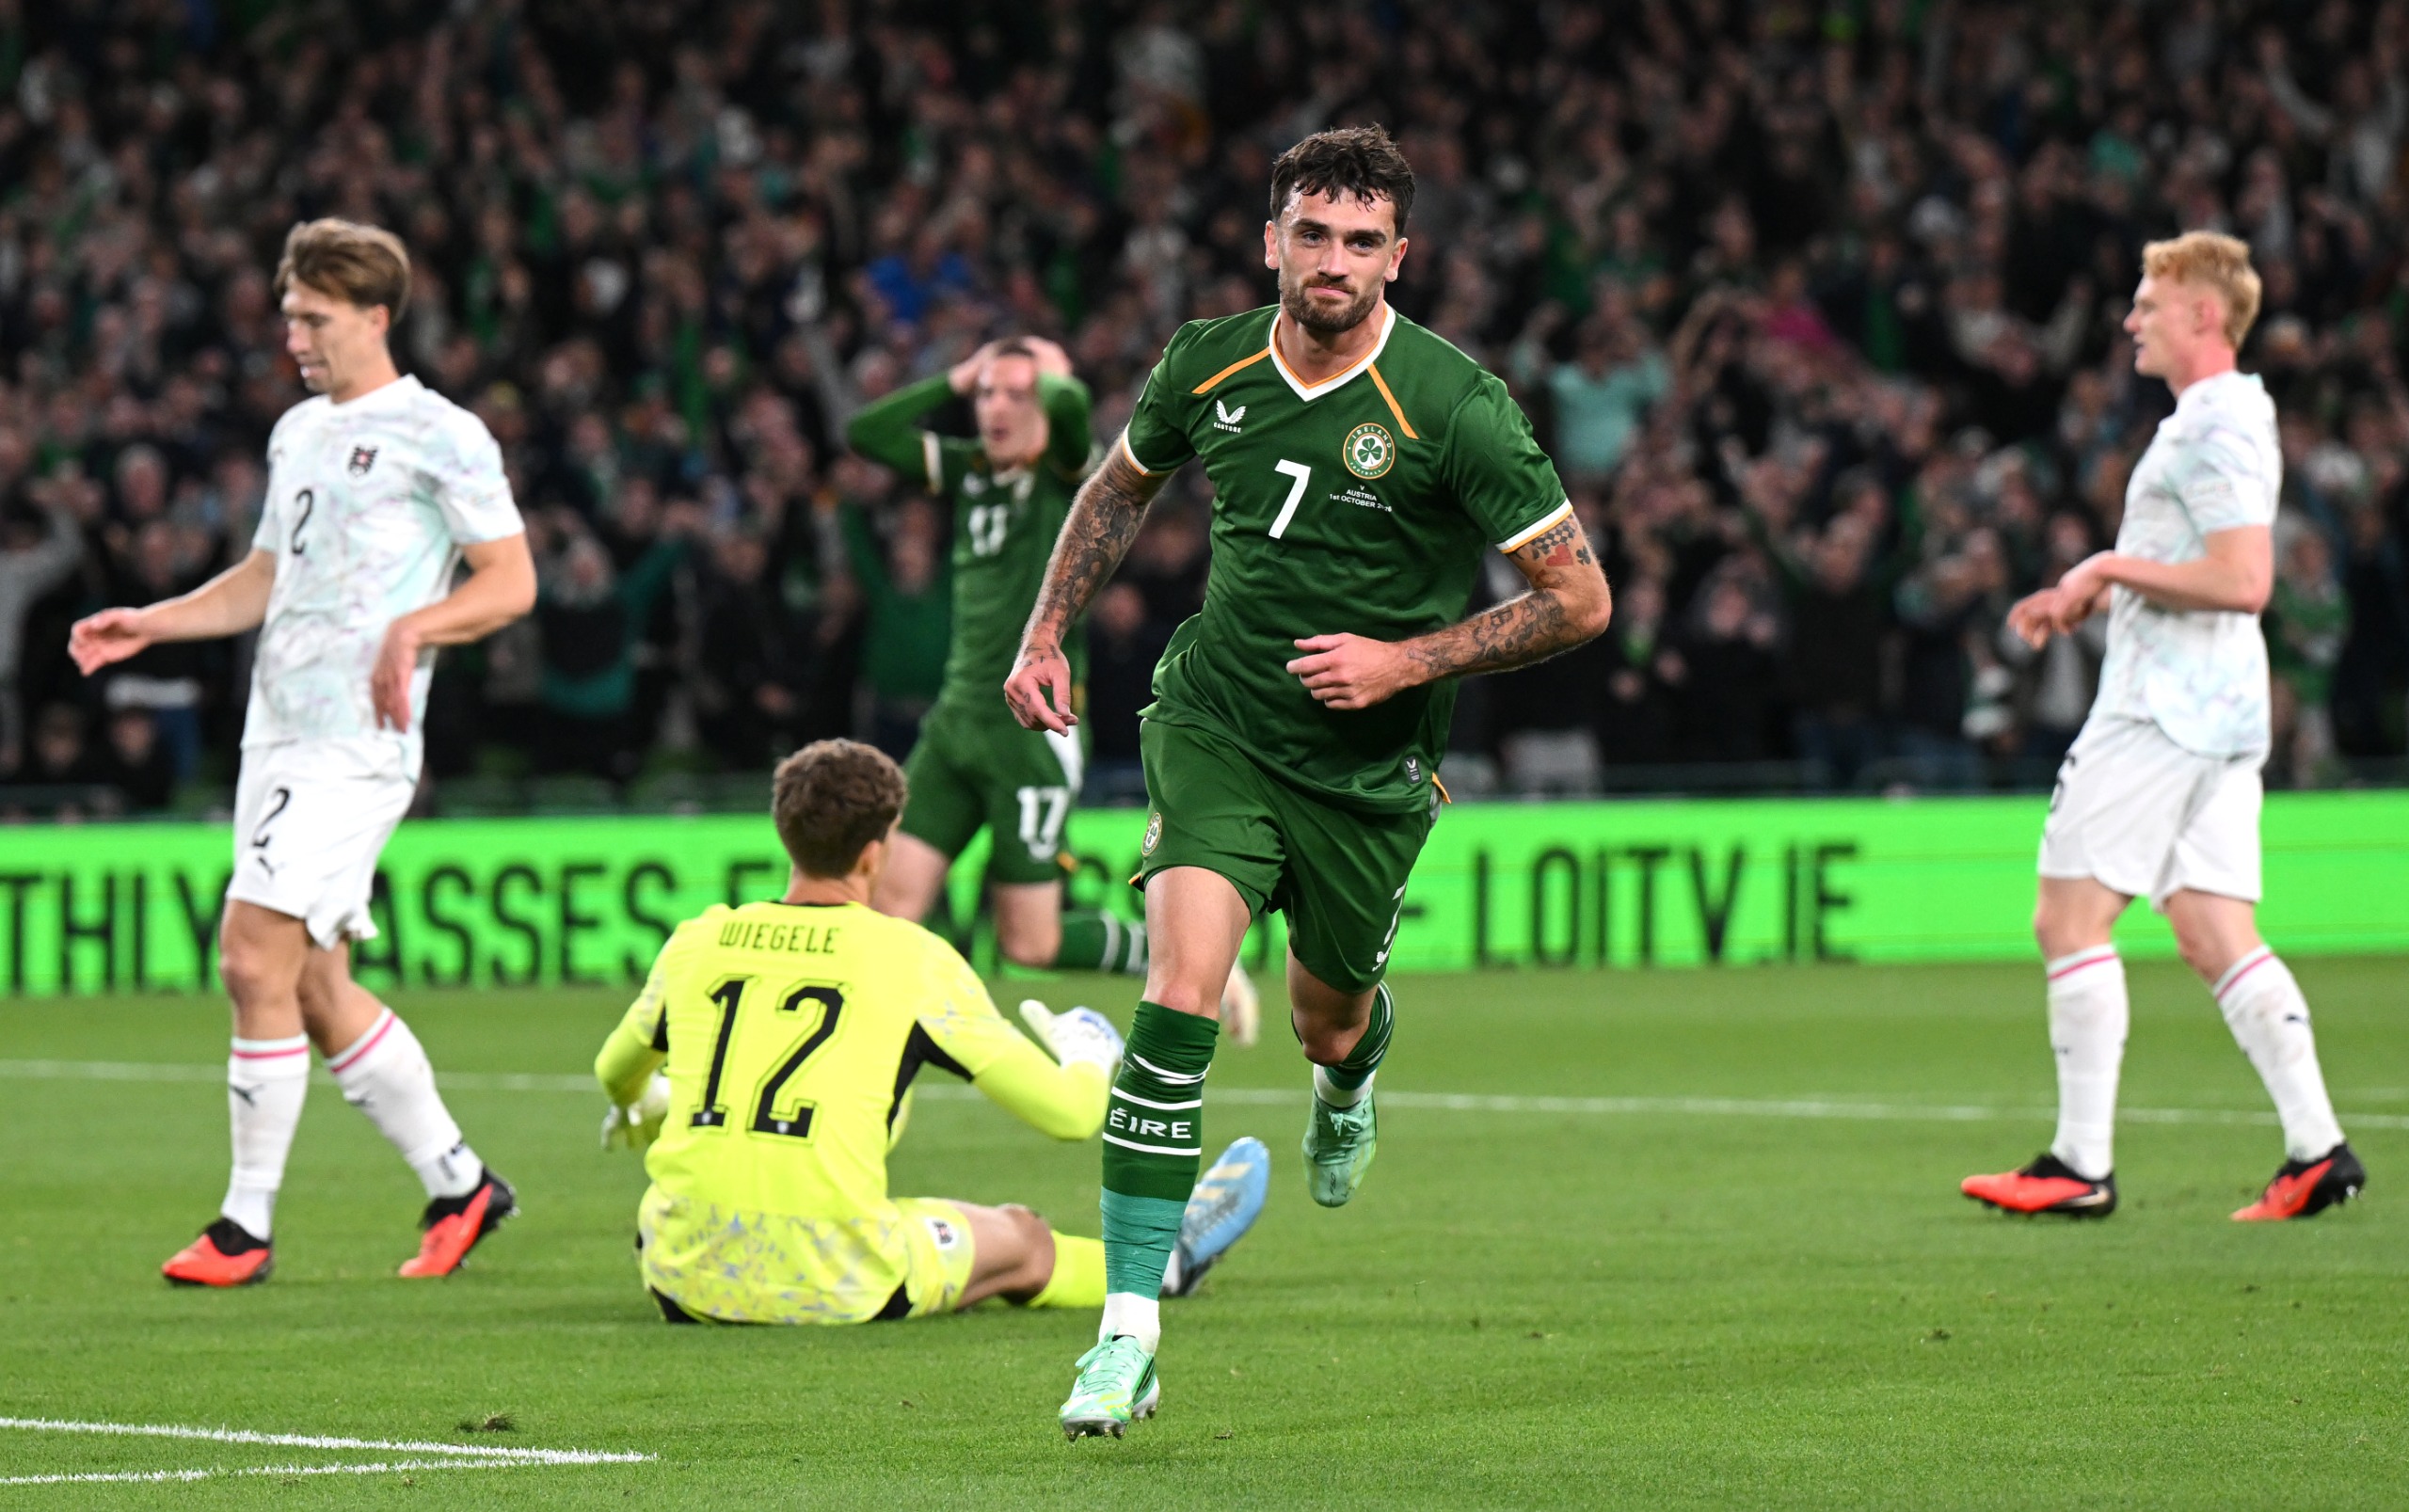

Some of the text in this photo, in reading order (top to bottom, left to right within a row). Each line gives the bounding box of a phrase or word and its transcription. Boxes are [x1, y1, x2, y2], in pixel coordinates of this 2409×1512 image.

[1351, 426, 1392, 448] IRELAND
[1268, 458, 1312, 540] 7
[1340, 495, 1376, 508] OCTOBER
[1346, 488, 1377, 501] AUSTRIA
[291, 488, 312, 555] 2
[251, 787, 290, 849] 2
[1016, 787, 1070, 843] 17
[718, 920, 840, 955] WIEGELE
[687, 974, 854, 1146] 12
[1109, 1106, 1192, 1139] ÉIRE
